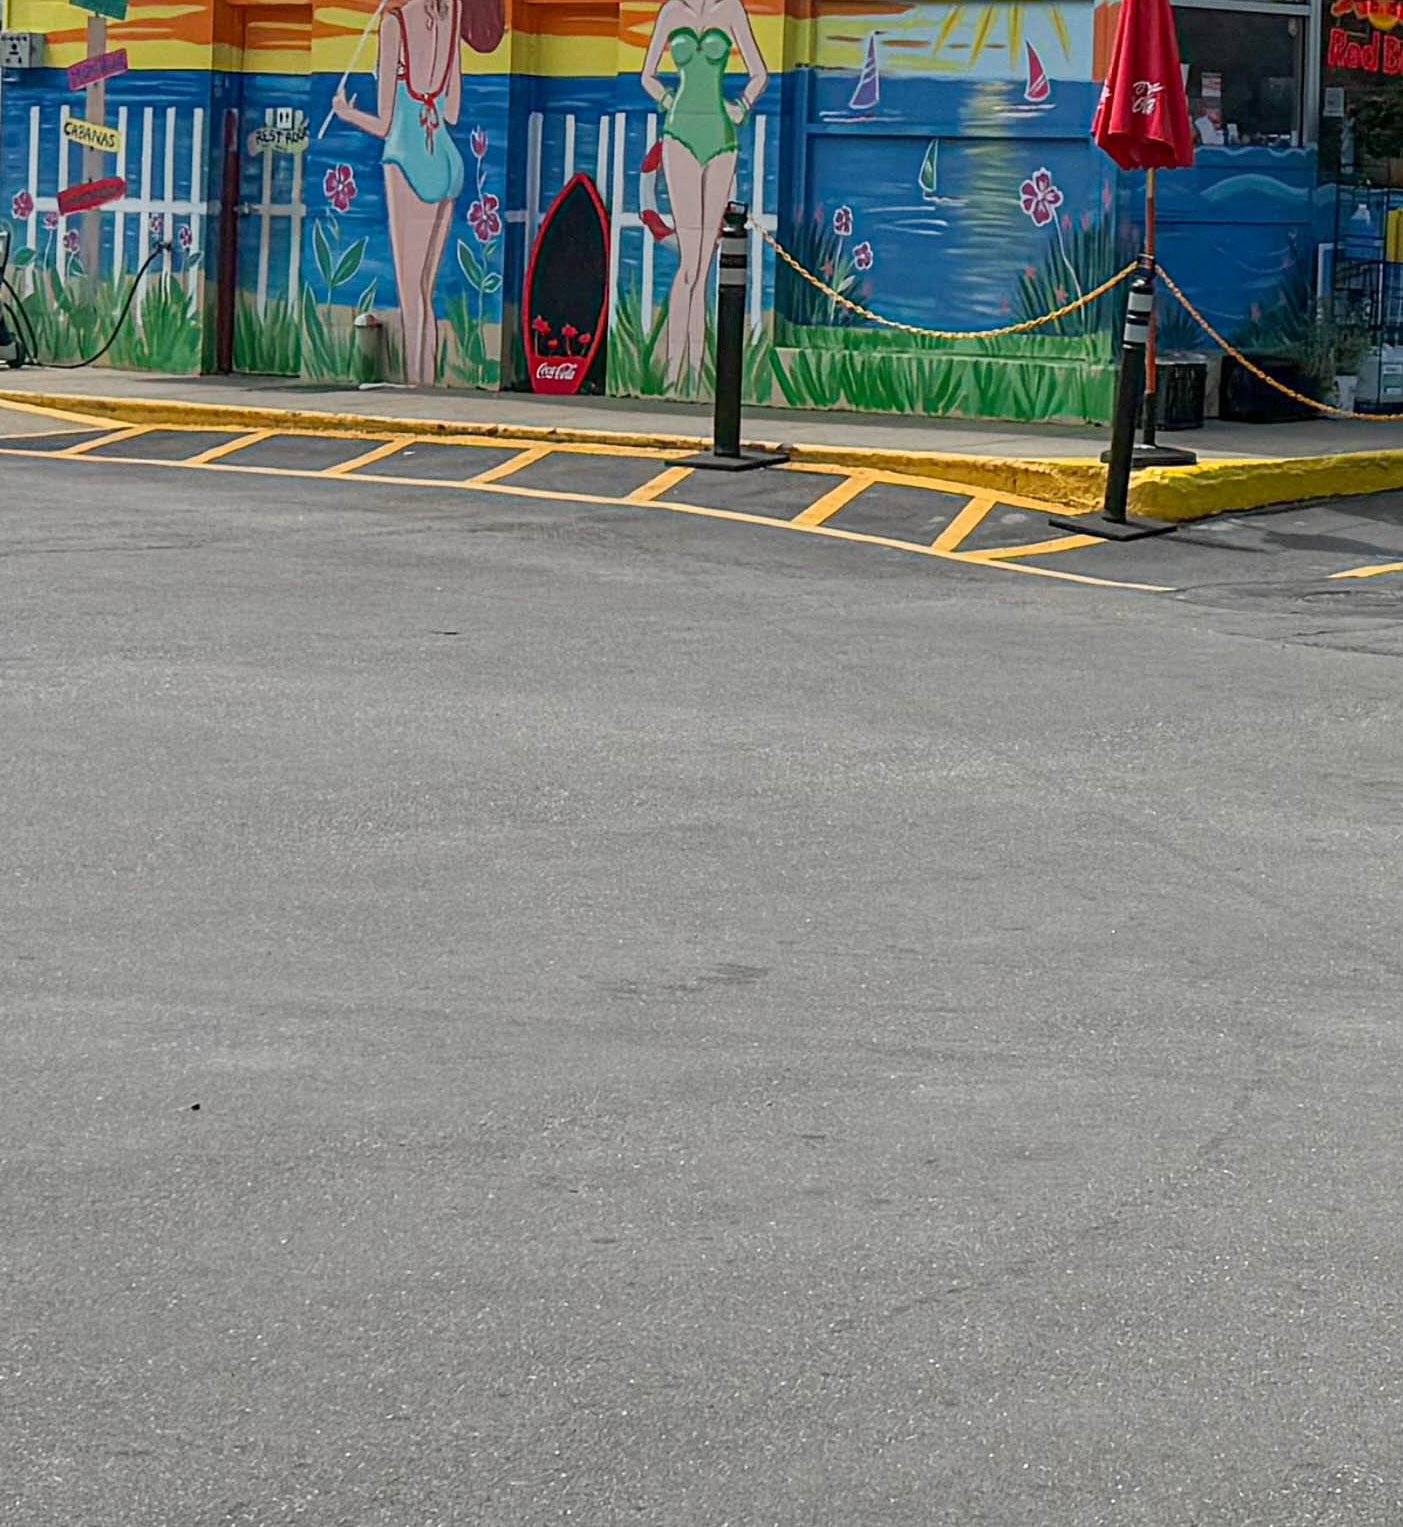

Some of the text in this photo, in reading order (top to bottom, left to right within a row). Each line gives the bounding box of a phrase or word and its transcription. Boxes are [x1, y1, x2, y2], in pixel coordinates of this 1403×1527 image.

[1327, 28, 1380, 73] Red
[64, 121, 115, 149] CABANAS
[256, 128, 281, 145] REST
